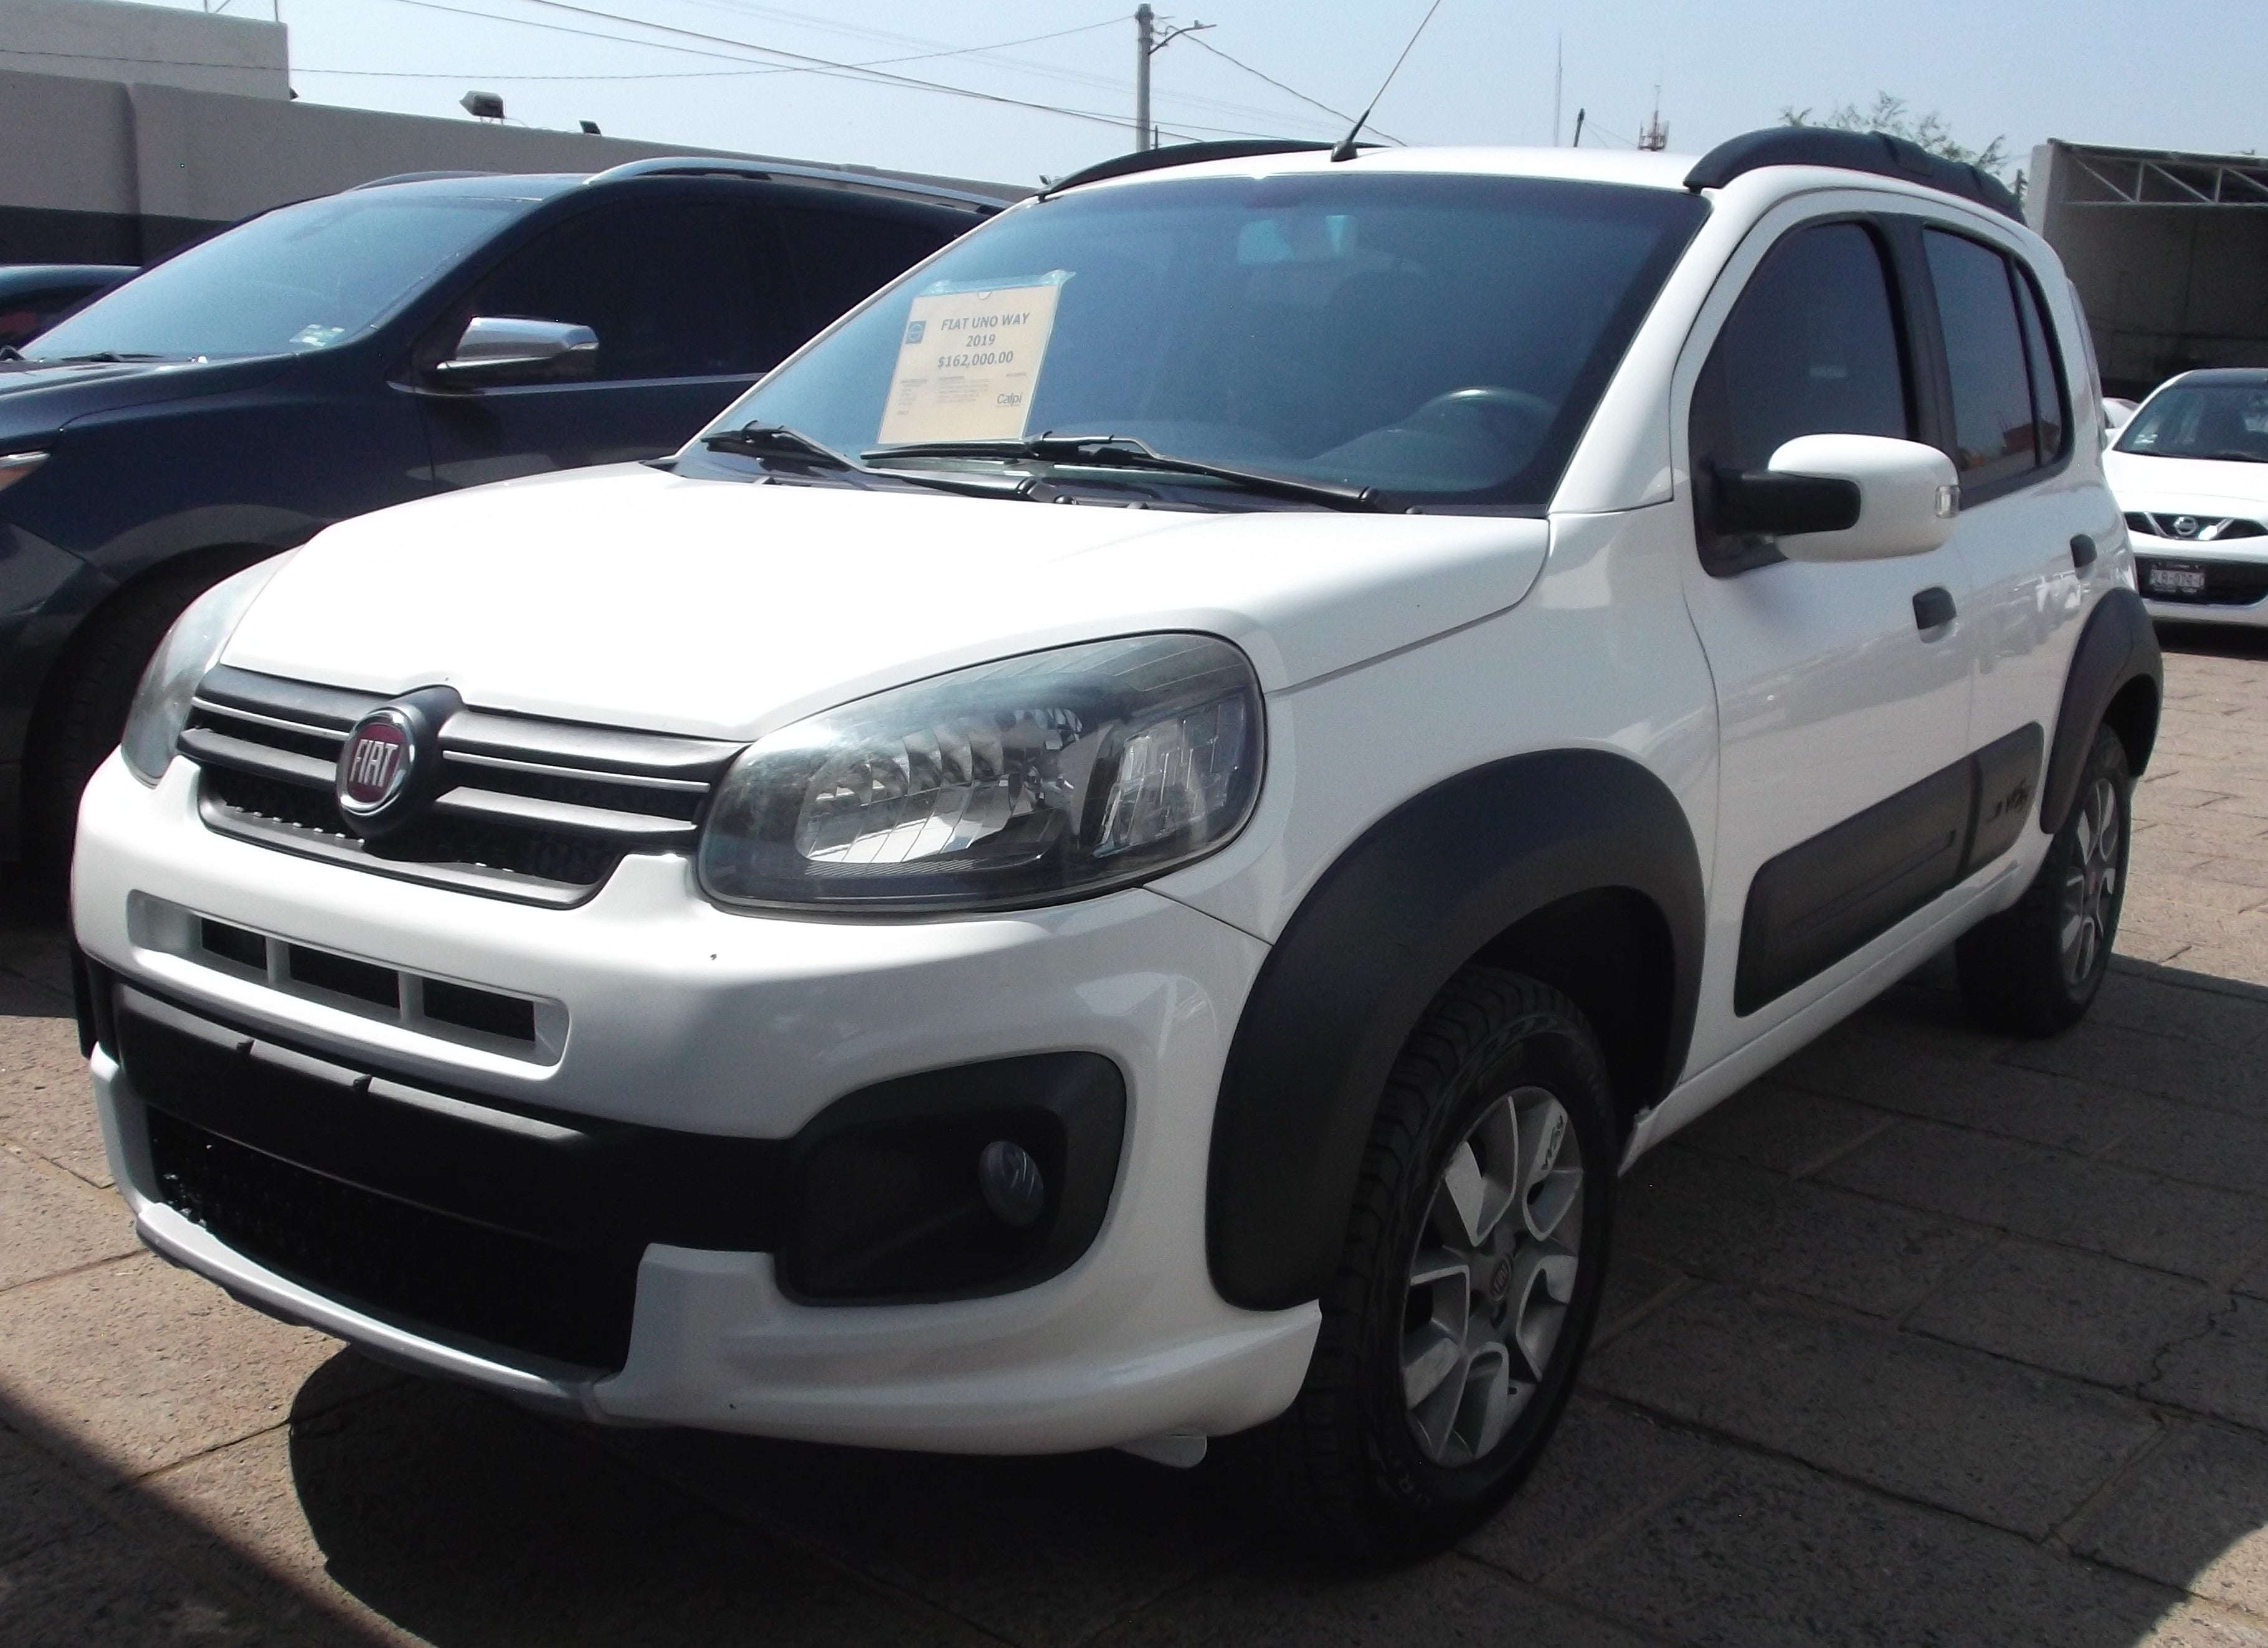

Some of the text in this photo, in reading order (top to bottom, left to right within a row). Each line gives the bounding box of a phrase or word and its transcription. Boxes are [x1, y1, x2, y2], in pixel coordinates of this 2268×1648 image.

[941, 313, 1030, 331] FIAT UNO WAY
[966, 334, 996, 347] 2019
[937, 350, 1013, 368] $162,000.00
[997, 392, 1023, 407] Calpi
[349, 738, 400, 788] FIAT
